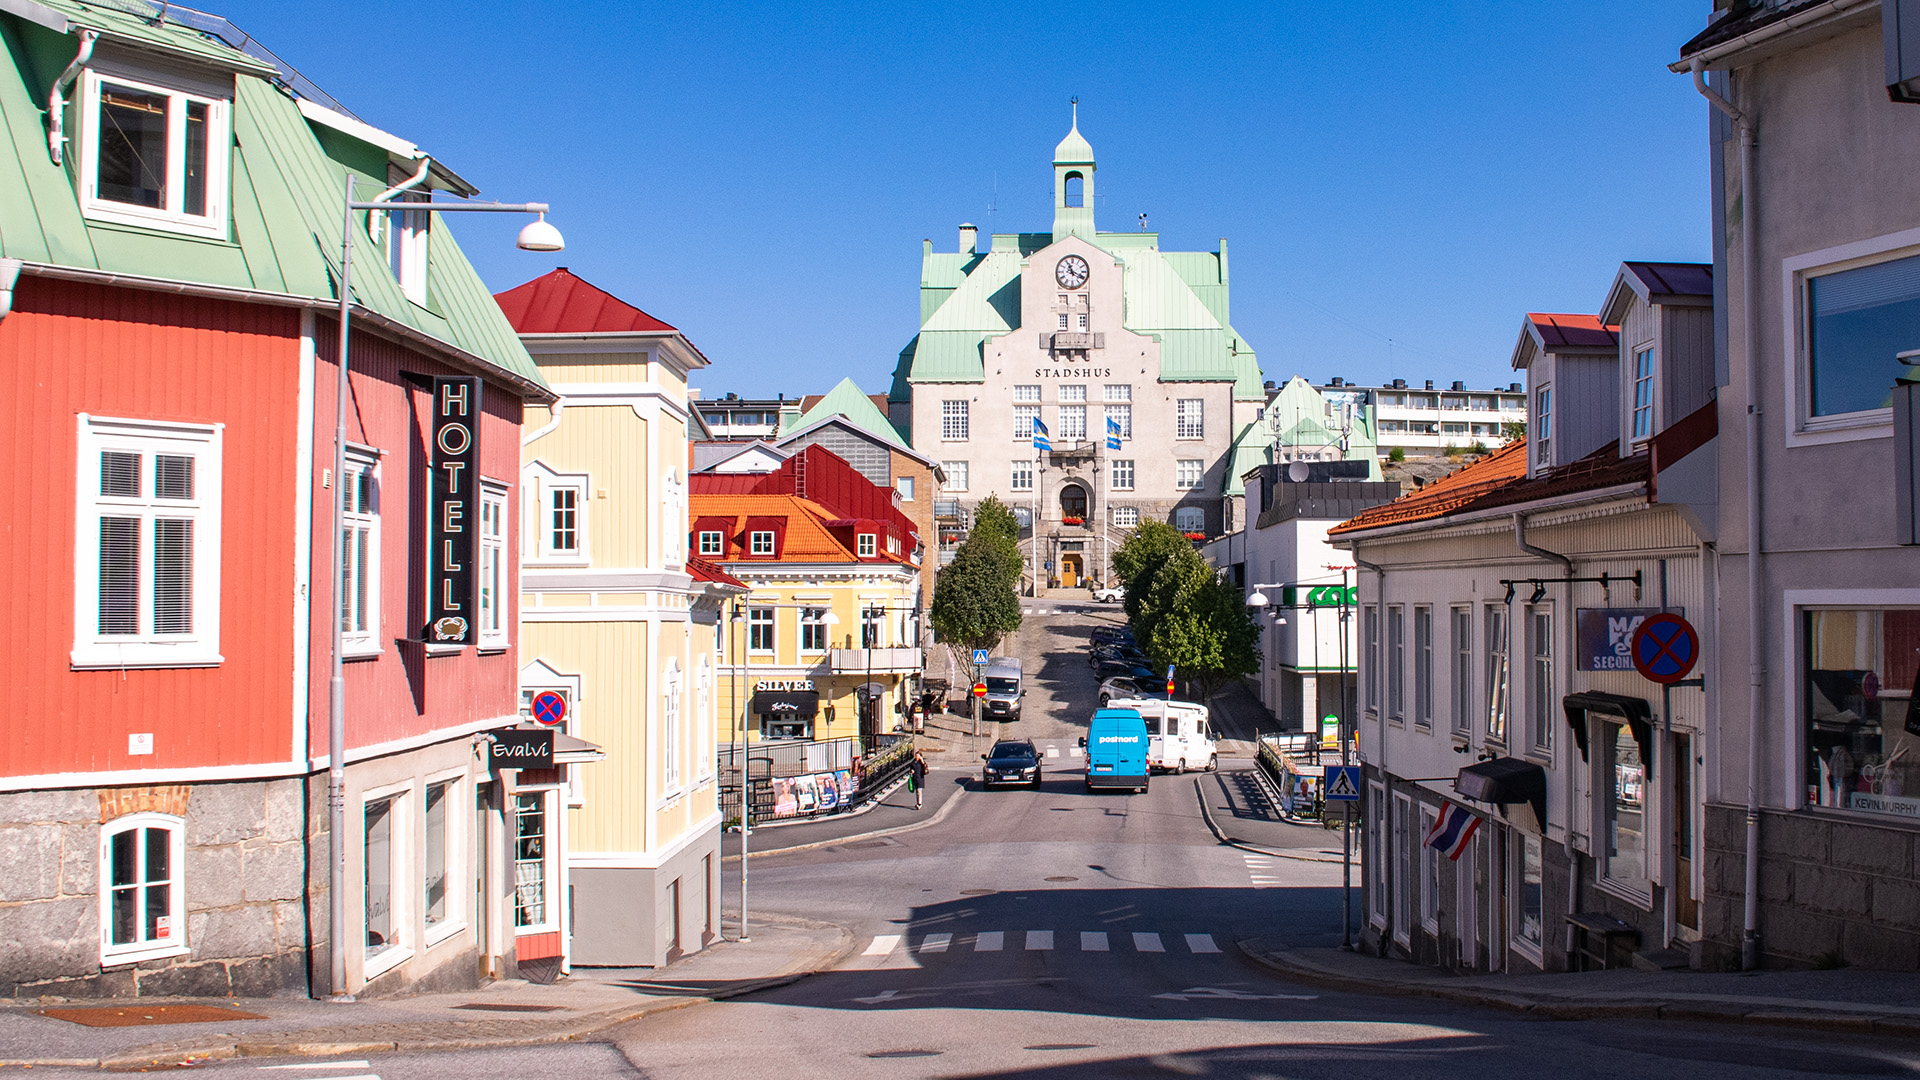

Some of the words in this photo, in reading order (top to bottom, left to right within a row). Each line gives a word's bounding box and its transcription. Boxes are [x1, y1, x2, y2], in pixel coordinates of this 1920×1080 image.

[1035, 368, 1111, 378] STADSHUS
[437, 384, 471, 610] HOTELL
[756, 680, 815, 692] SILVER
[1099, 736, 1138, 744] postnord
[493, 742, 549, 757] Evalvi
